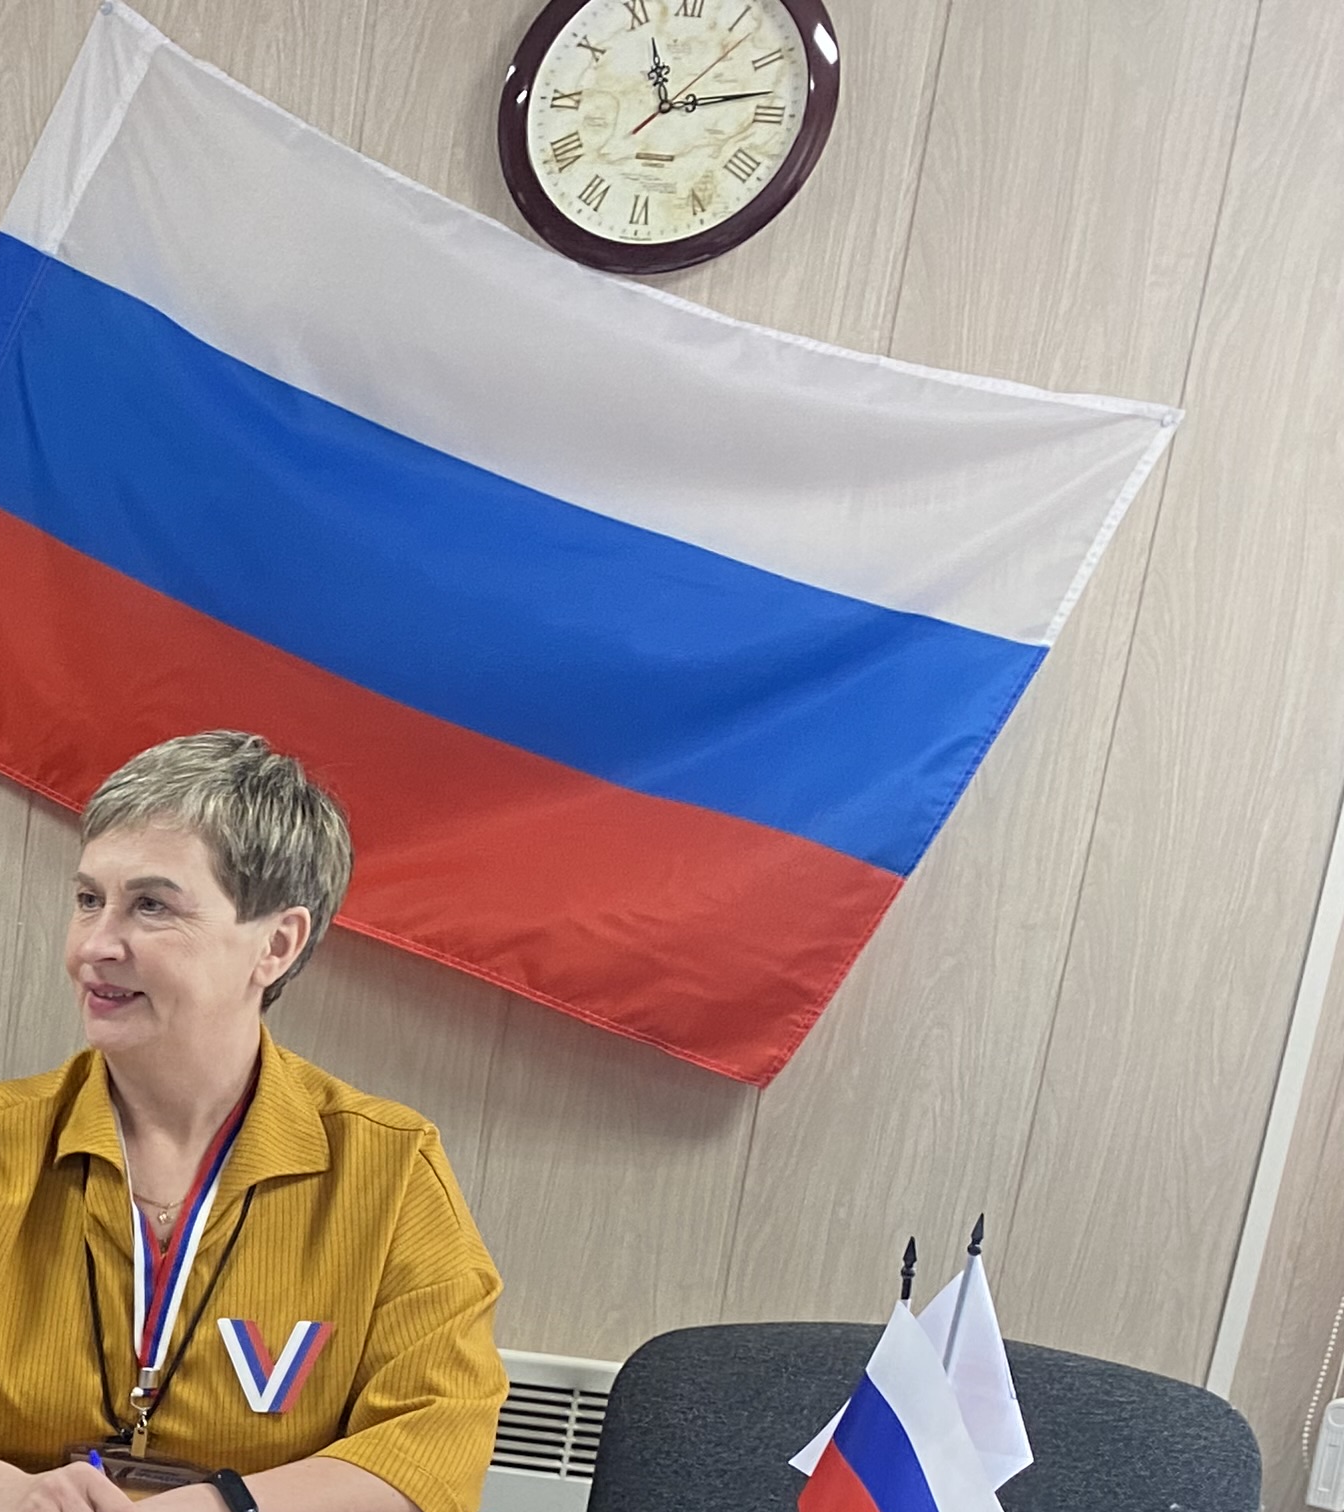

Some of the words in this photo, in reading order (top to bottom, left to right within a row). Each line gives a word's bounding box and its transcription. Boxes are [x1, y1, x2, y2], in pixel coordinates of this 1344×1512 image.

[577, 34, 606, 62] X
[751, 48, 785, 71] II
[550, 89, 583, 110] IX
[753, 105, 786, 125] III
[550, 130, 585, 173] VIII
[578, 174, 611, 212] VII
[629, 194, 649, 226] VI
